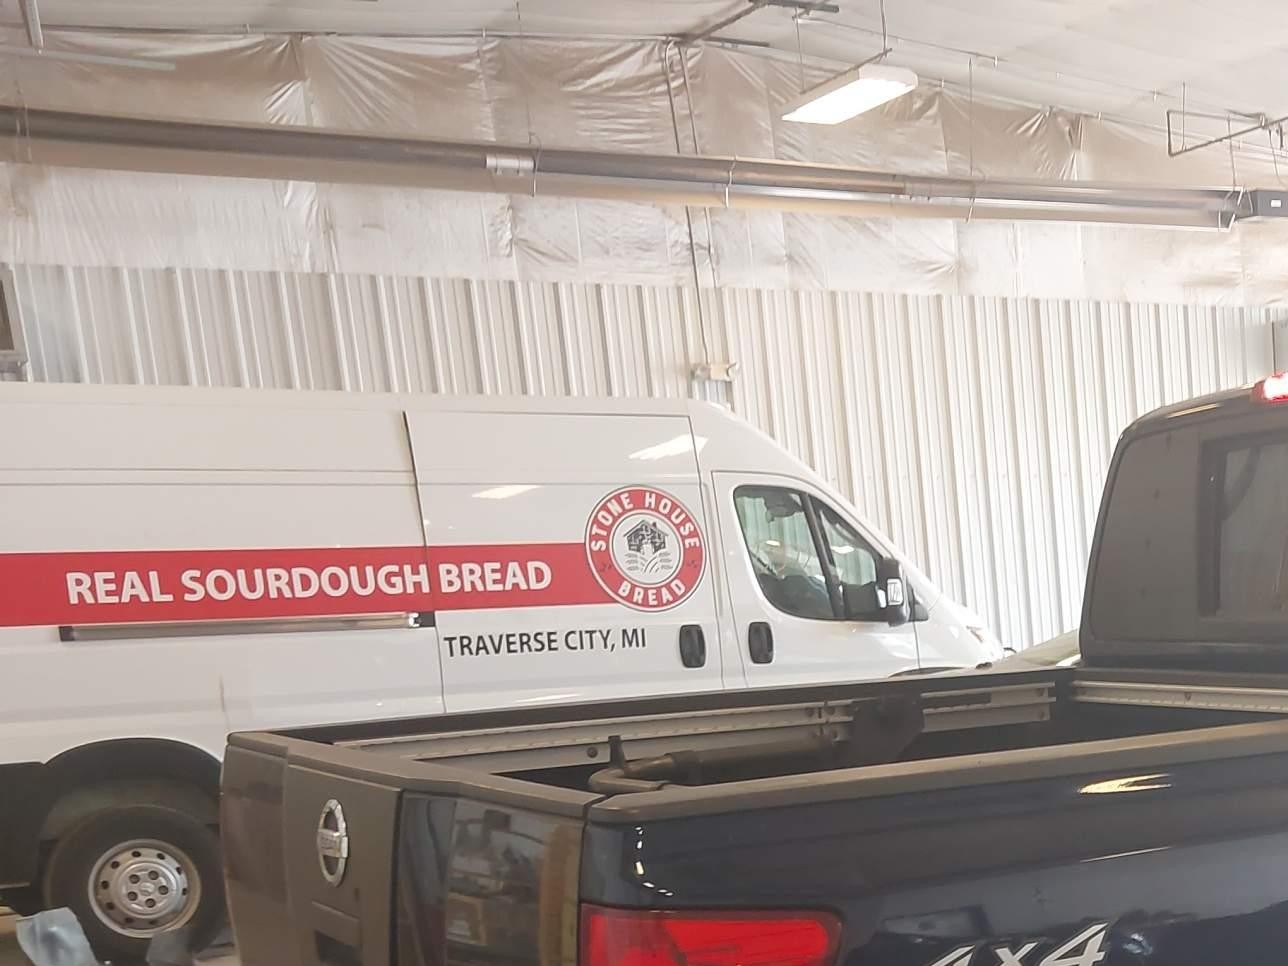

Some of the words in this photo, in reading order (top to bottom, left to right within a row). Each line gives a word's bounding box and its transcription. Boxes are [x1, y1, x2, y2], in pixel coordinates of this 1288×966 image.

[590, 492, 634, 552] STONE
[644, 491, 700, 549] HOUSE
[66, 571, 174, 605] REAL
[181, 563, 430, 601] SOURDOUGH
[438, 560, 552, 594] BREAD
[617, 578, 686, 606] BREAD
[444, 631, 559, 657] TRAVERSE
[564, 628, 616, 652] CITY,
[621, 627, 647, 649] MI
